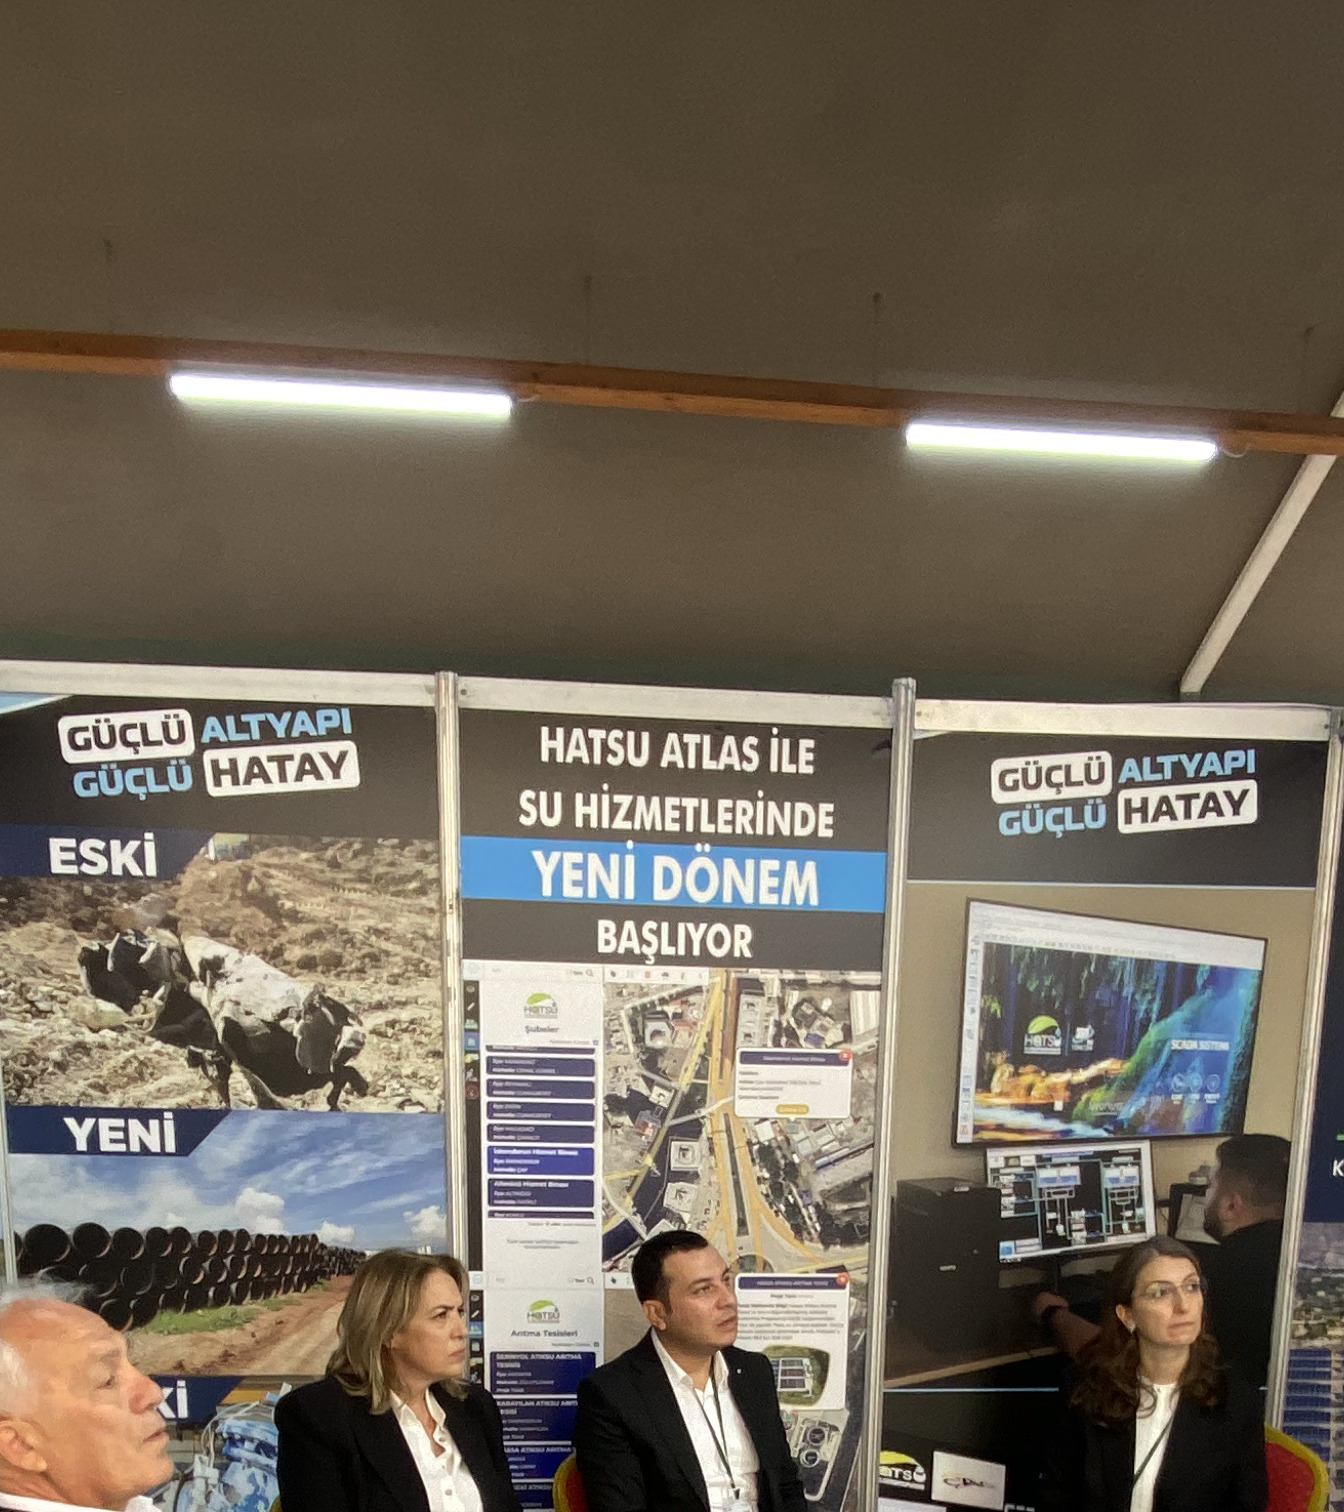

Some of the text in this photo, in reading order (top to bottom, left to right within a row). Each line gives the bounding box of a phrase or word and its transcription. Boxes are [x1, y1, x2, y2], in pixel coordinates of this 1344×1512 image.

[66, 707, 353, 754] GÜÇLÜ ALTYAPI
[540, 726, 816, 775] HATSU ATLAS İLE
[73, 749, 350, 801] GÜÇLÜ HATAY
[998, 749, 1256, 795] GÜÇLÜ ALTYAPI
[519, 782, 835, 838] SU HİZMETLERİNDE
[998, 789, 1250, 838] GÜÇLÜ HATAY
[48, 832, 157, 877] ESKİ
[532, 839, 819, 907] YENİ DÖNEM
[597, 919, 753, 964] BAŞLIYOR
[63, 1112, 177, 1153] YENİ
